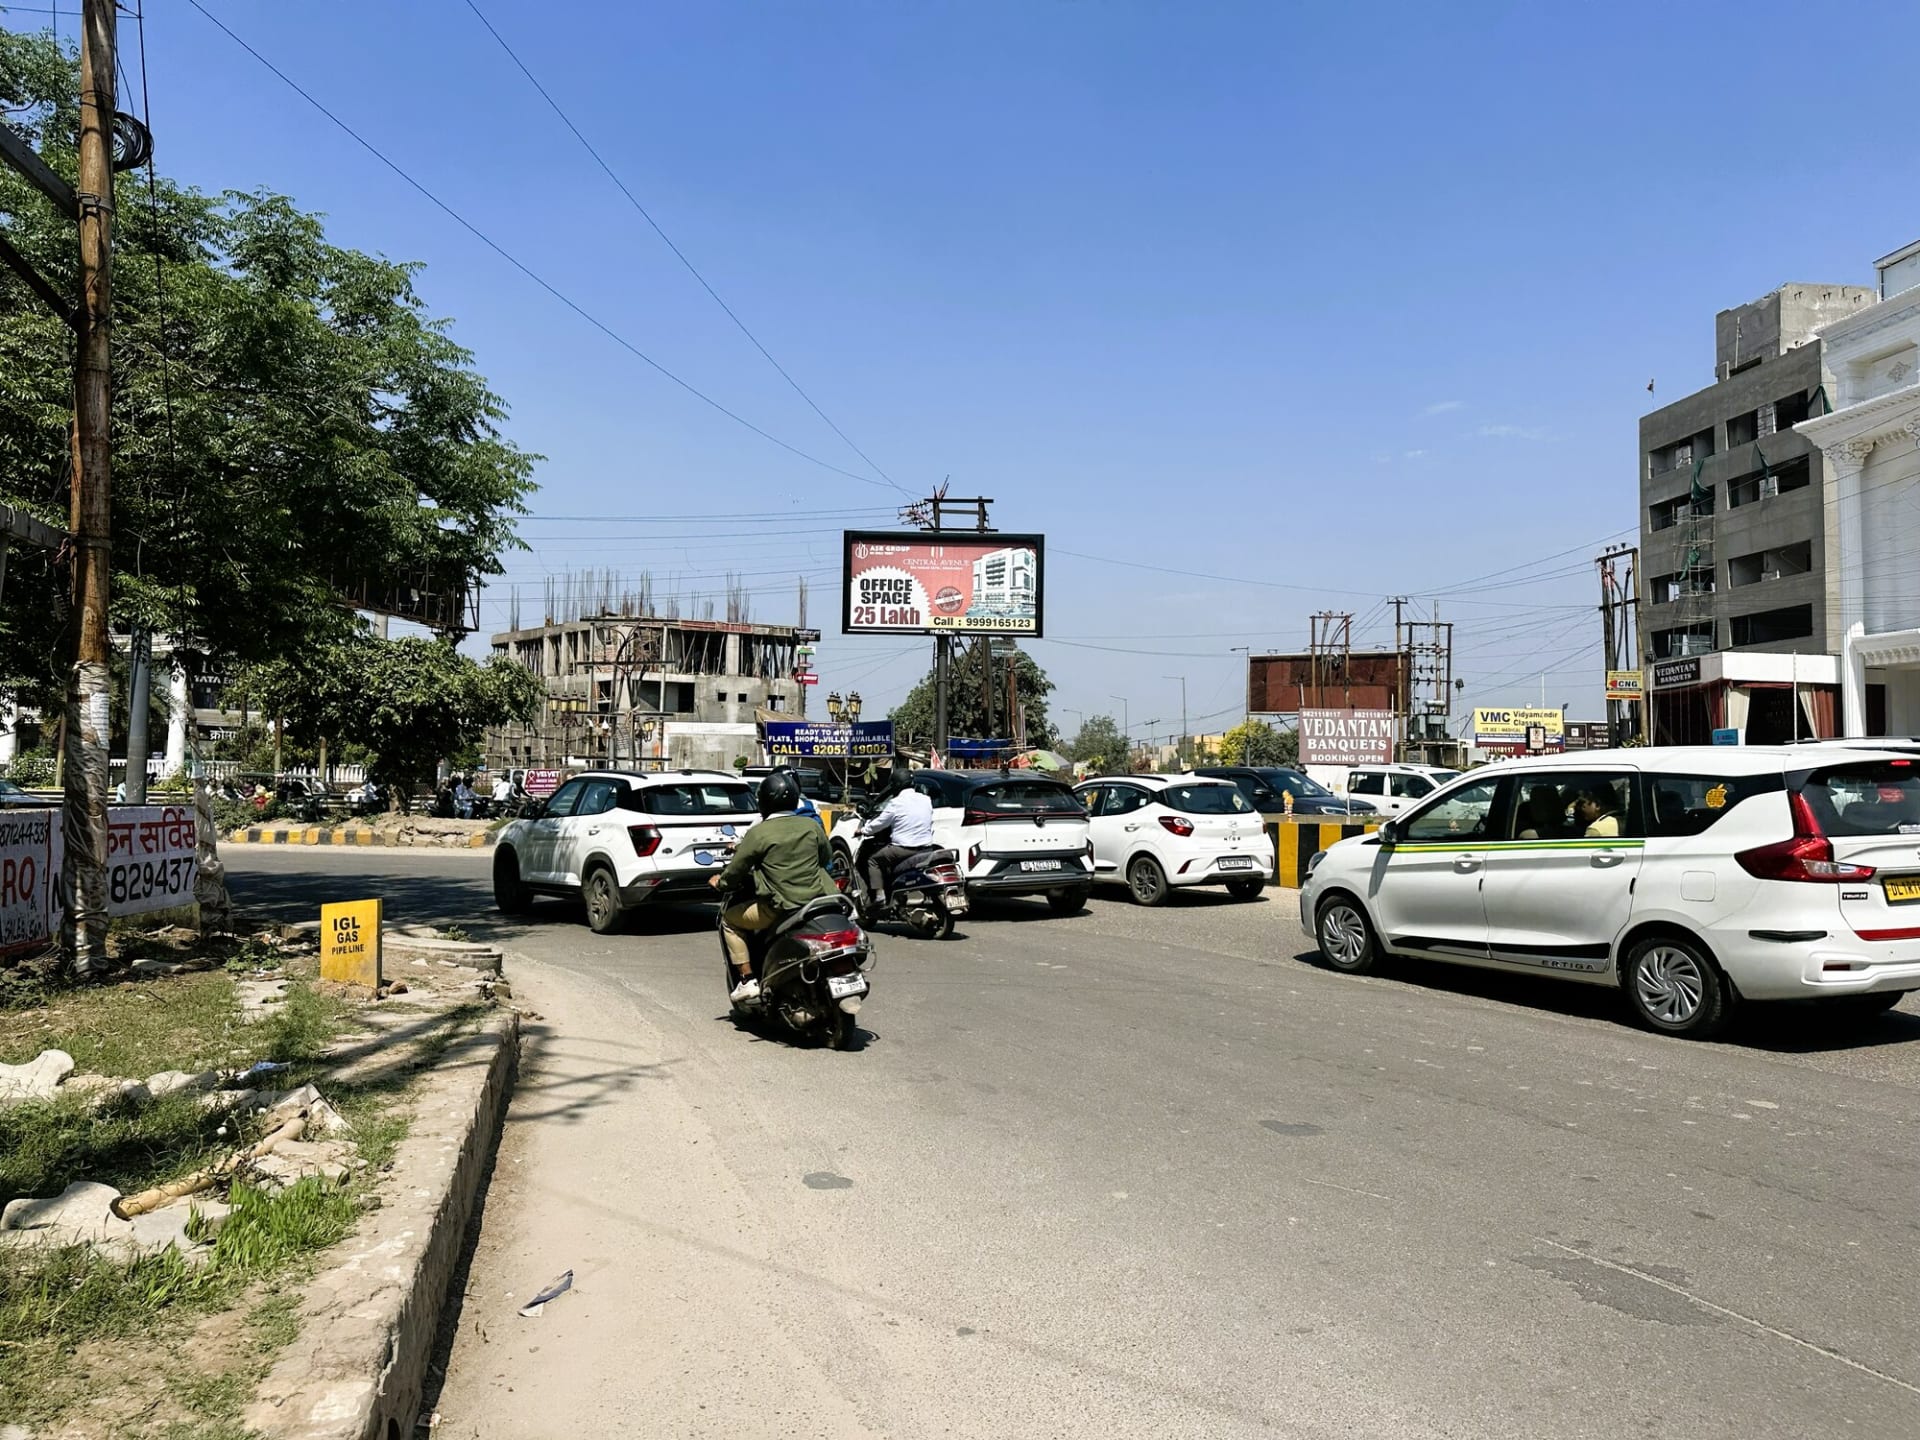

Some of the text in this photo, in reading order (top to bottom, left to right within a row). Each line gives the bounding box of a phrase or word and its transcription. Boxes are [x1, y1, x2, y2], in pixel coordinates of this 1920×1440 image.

[903, 559, 971, 567] CENTRAL AVENUE
[859, 578, 913, 591] OFFICE
[860, 591, 912, 605] SPACE
[853, 606, 920, 625] 25 Lakh
[933, 616, 954, 626] Call
[966, 617, 1031, 628] 9999165123
[1618, 680, 1638, 688] CNG
[1480, 711, 1511, 723] VMC
[795, 728, 819, 736] READY
[821, 728, 831, 736] TO
[1302, 718, 1392, 737] VEDANTAM
[851, 734, 891, 742] AVAILABLE
[772, 744, 802, 754] CALL
[812, 744, 849, 755] 92052
[1307, 738, 1387, 753] BANQUETS
[1311, 754, 1385, 763] BOOKING OPEN
[536, 770, 560, 778] VELVET
[333, 916, 360, 931] IGL
[336, 931, 358, 944] GAS
[331, 944, 364, 955] PIPE LINE
[1542, 959, 1594, 971] ERTIGA
